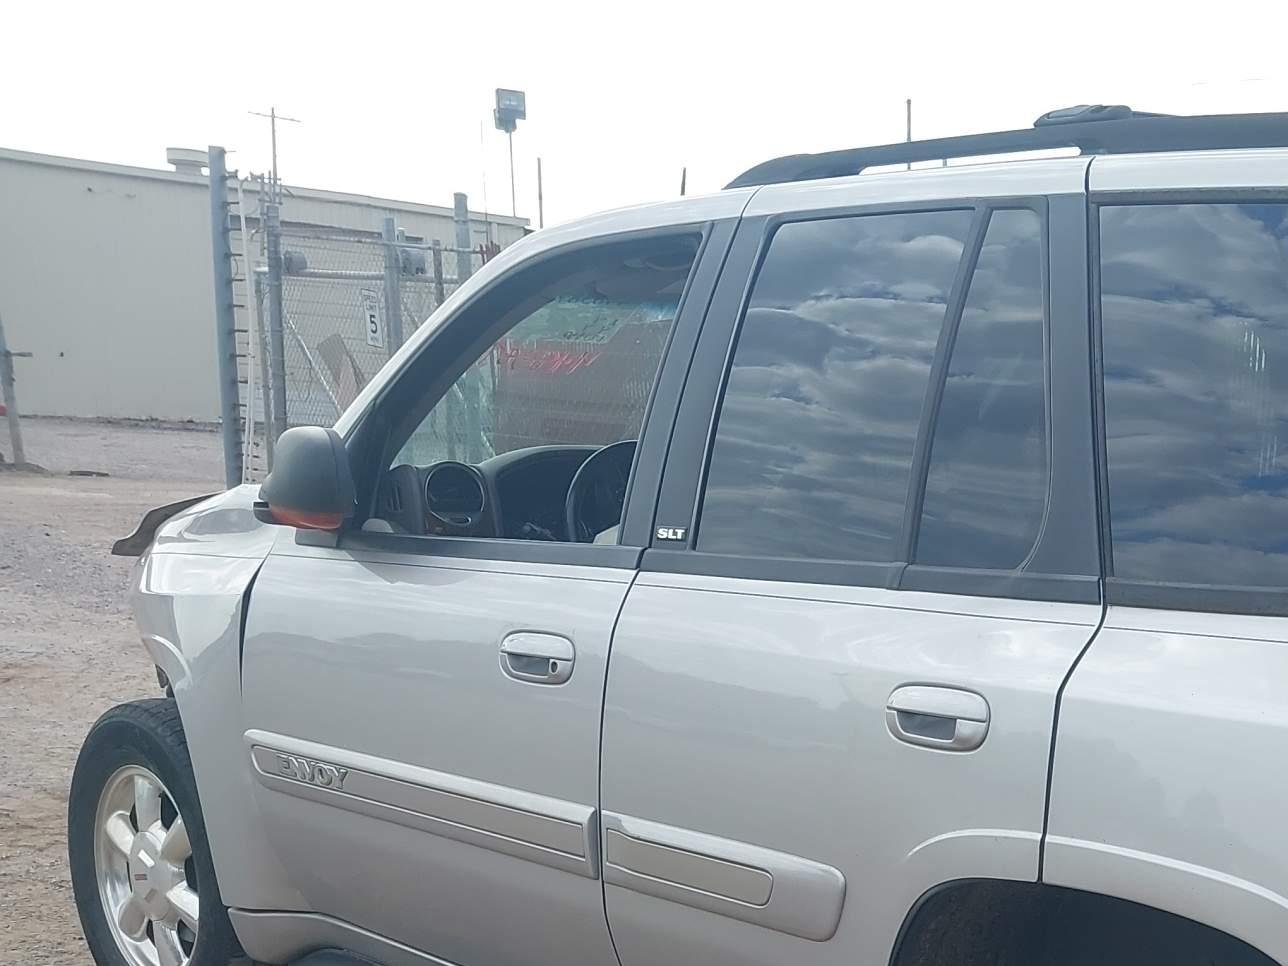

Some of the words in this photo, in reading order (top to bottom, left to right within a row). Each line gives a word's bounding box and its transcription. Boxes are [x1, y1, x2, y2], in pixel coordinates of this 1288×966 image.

[369, 314, 378, 335] 5
[656, 527, 686, 540] SLT
[275, 753, 349, 790] ENVOY
